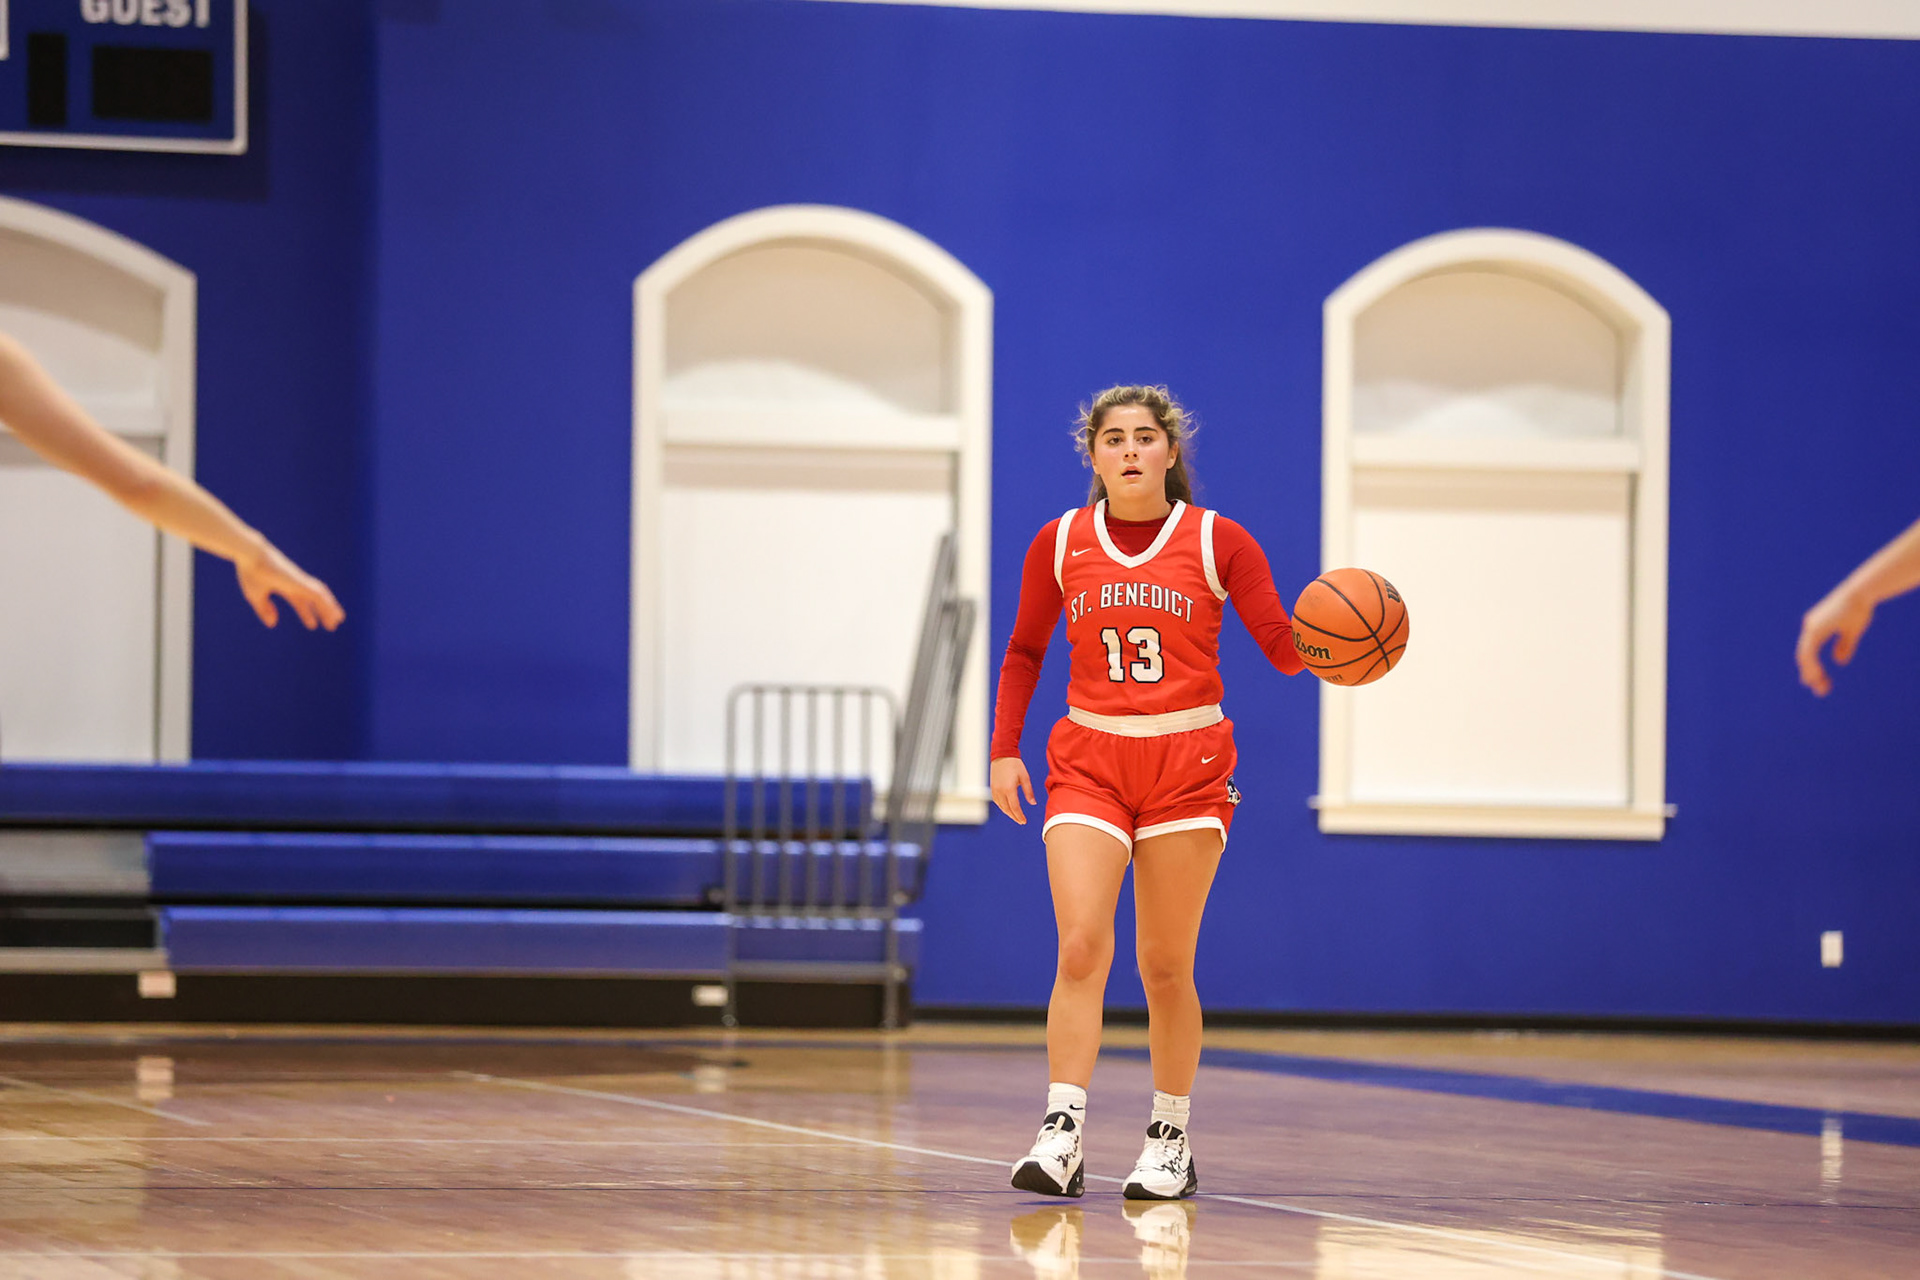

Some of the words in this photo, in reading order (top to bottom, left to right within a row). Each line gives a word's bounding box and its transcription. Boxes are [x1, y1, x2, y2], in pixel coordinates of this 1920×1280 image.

[1071, 590, 1092, 623] ST.
[1100, 582, 1194, 622] BENEDICT
[1100, 626, 1164, 683] 13
